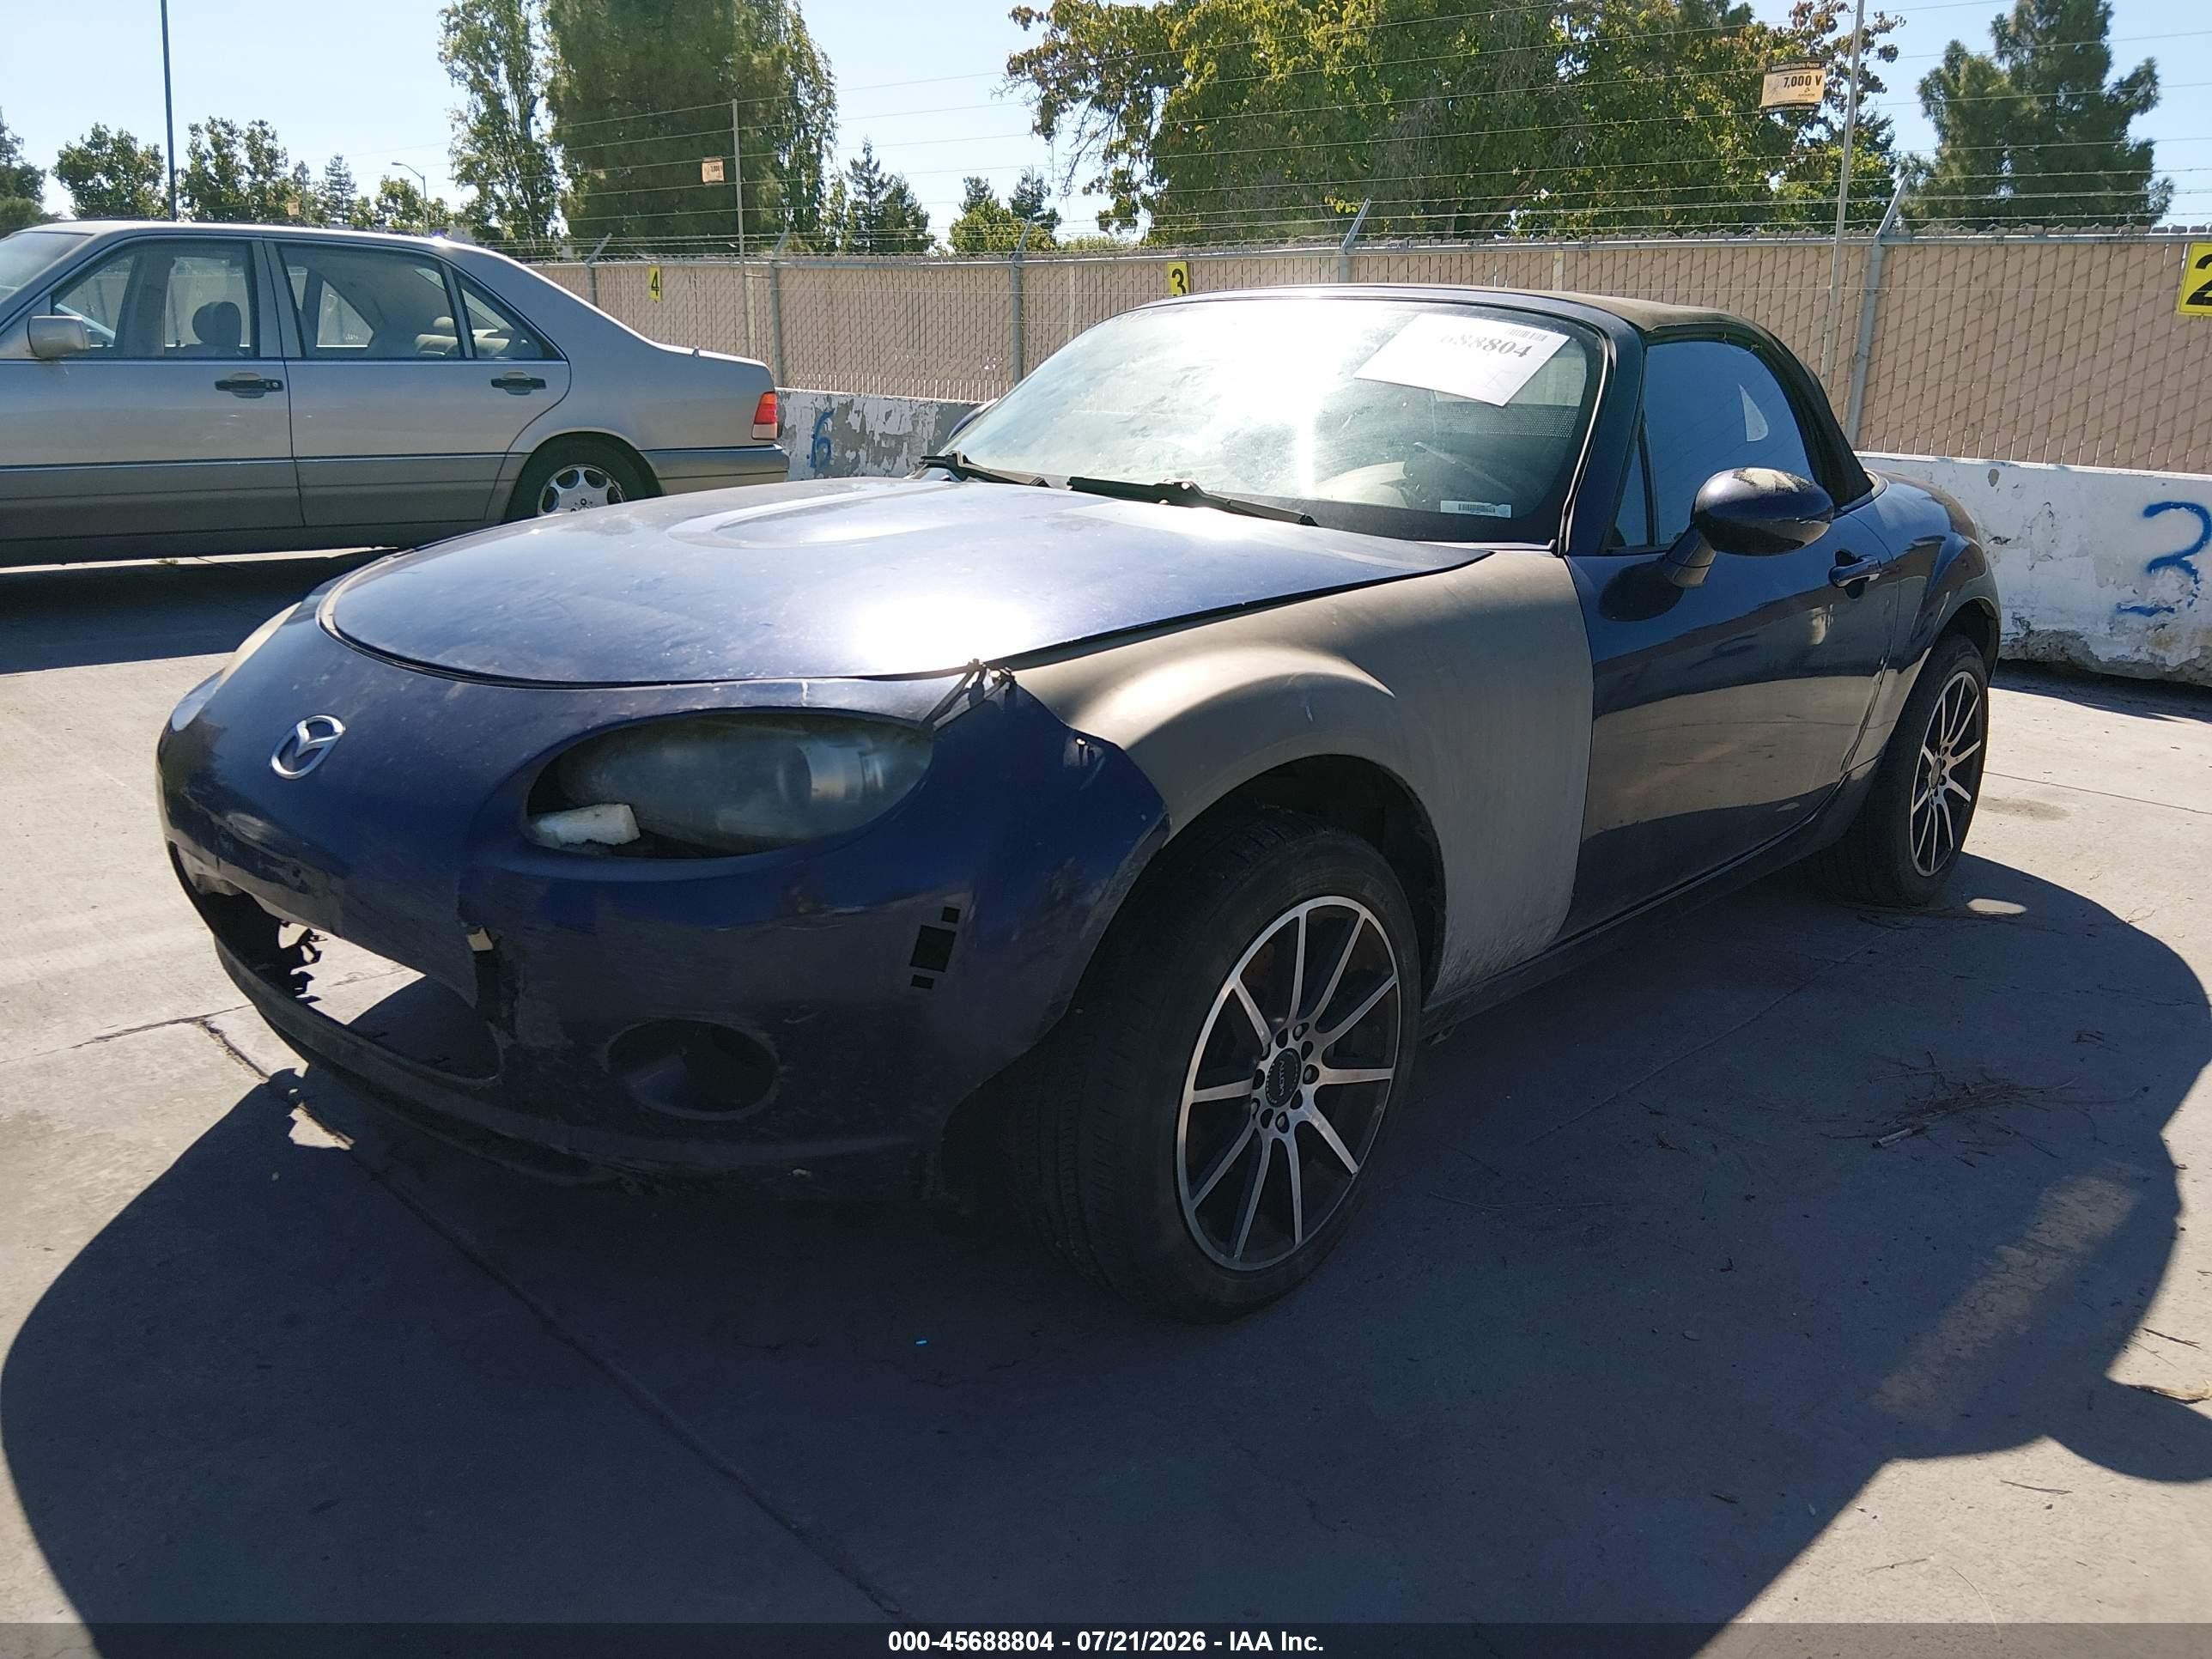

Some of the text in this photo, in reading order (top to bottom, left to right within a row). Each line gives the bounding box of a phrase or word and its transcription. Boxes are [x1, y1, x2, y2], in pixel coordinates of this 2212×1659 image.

[1784, 75, 1822, 89] 7,000 V
[651, 270, 659, 296] 4
[1171, 268, 1186, 296] 3
